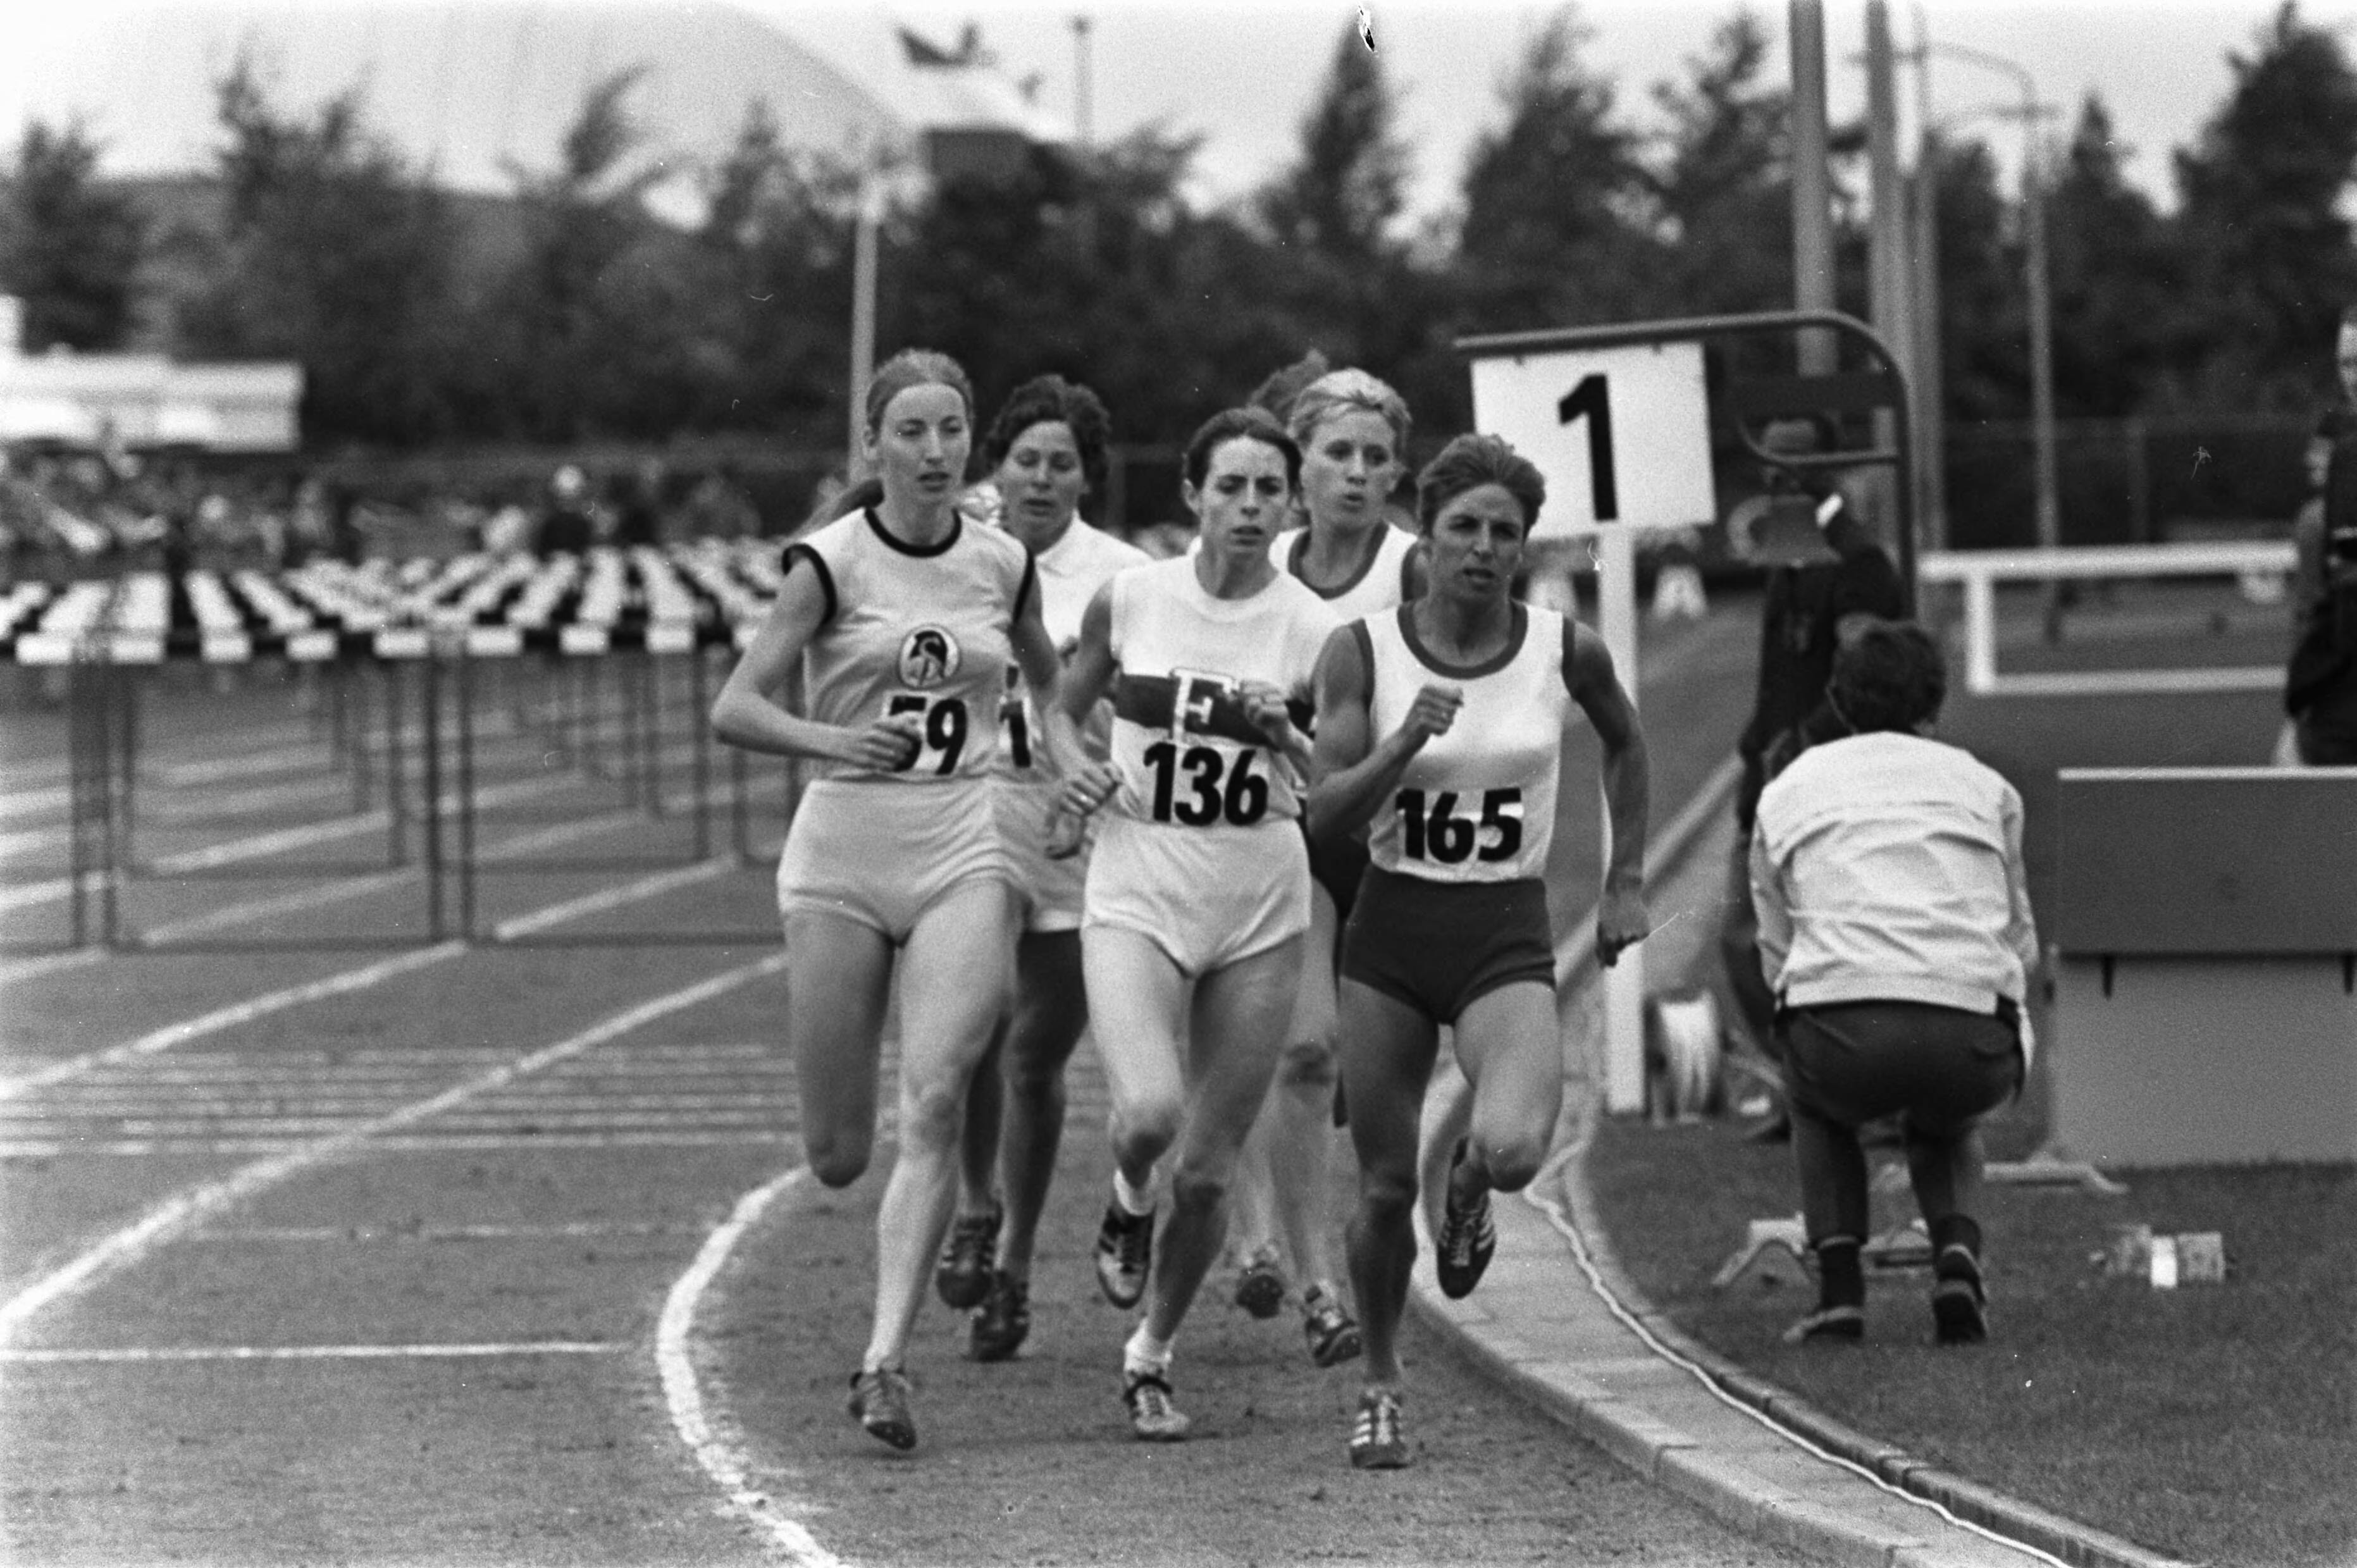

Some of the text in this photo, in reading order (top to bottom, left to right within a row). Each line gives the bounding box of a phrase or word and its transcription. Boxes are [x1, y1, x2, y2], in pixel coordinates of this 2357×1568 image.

[1558, 373, 1618, 522] 1
[889, 695, 967, 775] 59
[1144, 741, 1268, 827] 136
[1395, 787, 1521, 864] 165
